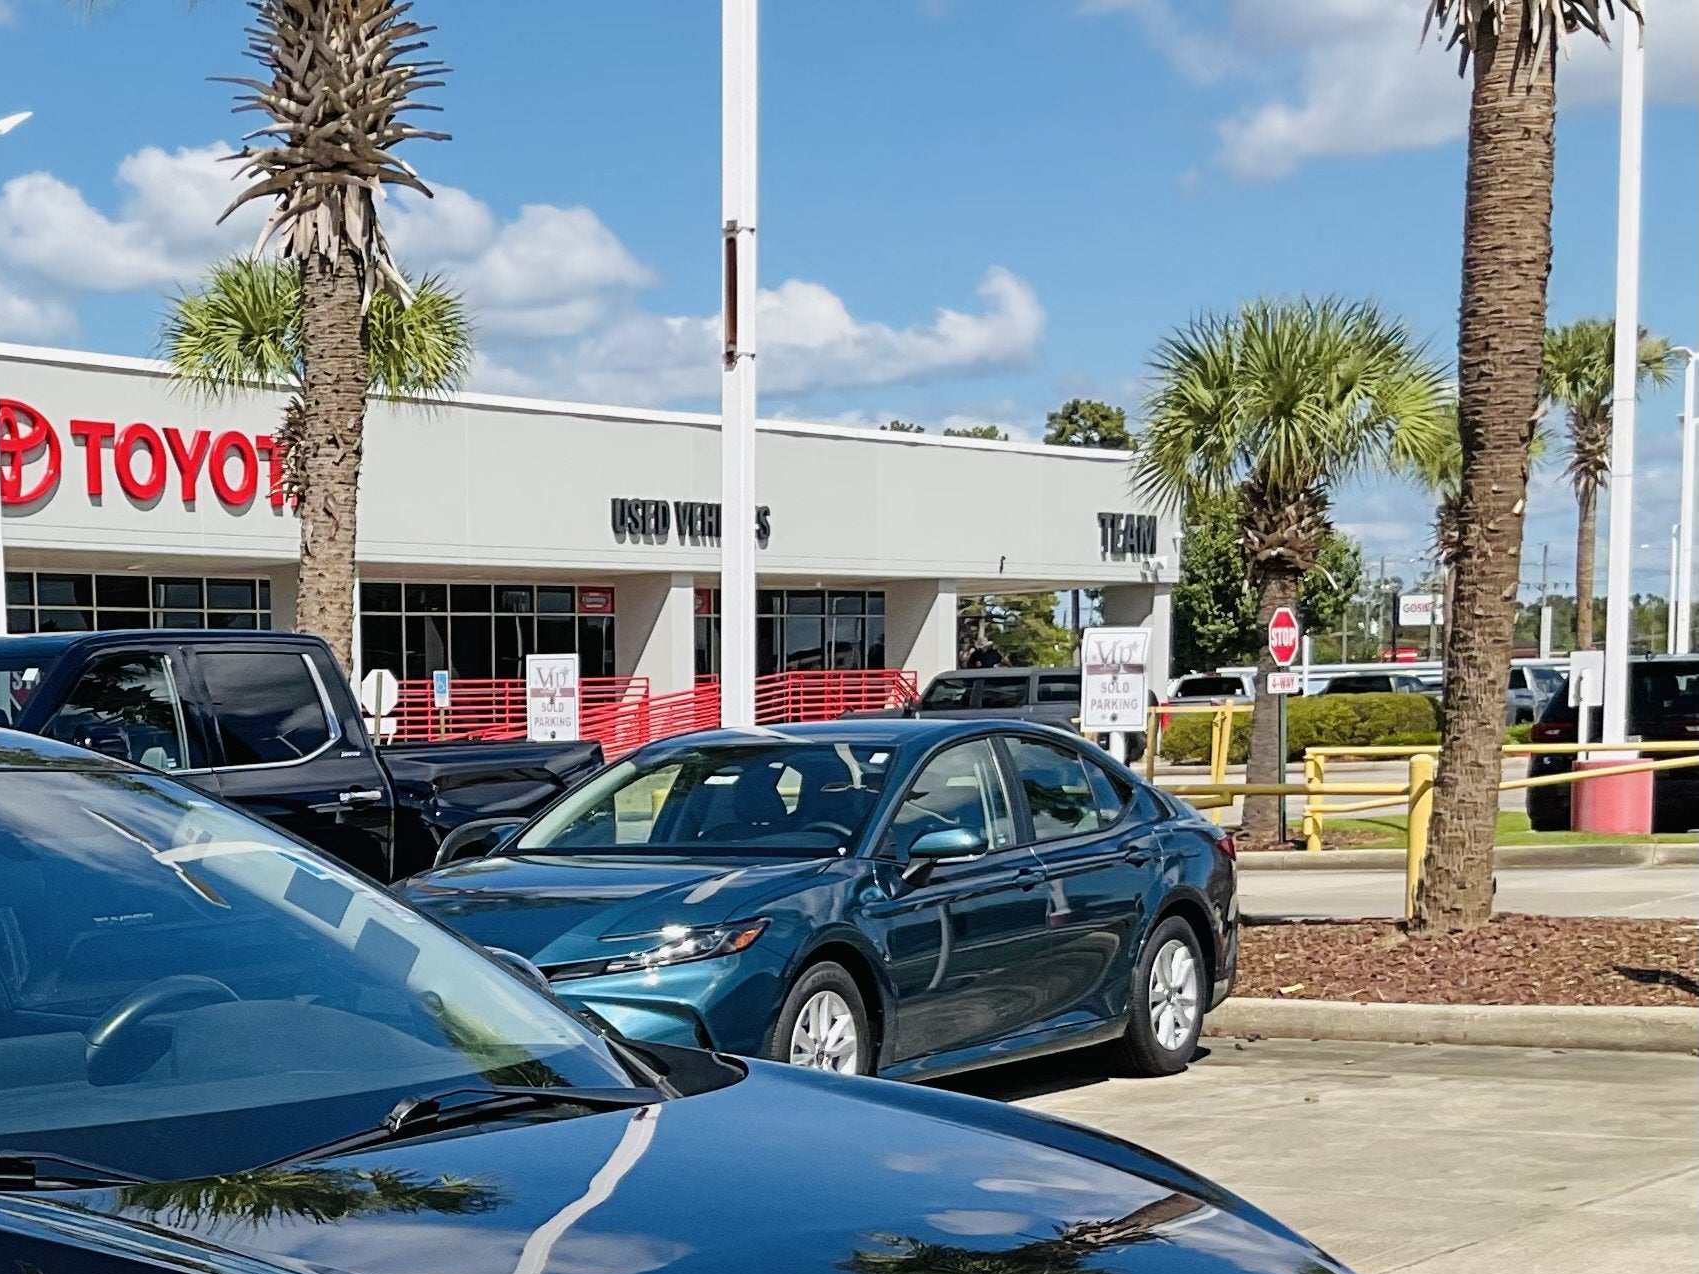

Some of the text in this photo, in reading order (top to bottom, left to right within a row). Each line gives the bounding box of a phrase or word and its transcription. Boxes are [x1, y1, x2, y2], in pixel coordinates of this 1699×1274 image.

[70, 420, 301, 511] TOYOT
[611, 498, 770, 541] USED VEHS
[1097, 512, 1157, 554] TEAM
[1271, 627, 1296, 647] STOP
[1101, 682, 1130, 693] SOLD
[1272, 677, 1295, 689] 4-WAY
[541, 703, 564, 713] SOLD
[1090, 699, 1138, 710] PARKING
[534, 717, 571, 727] PARKING
